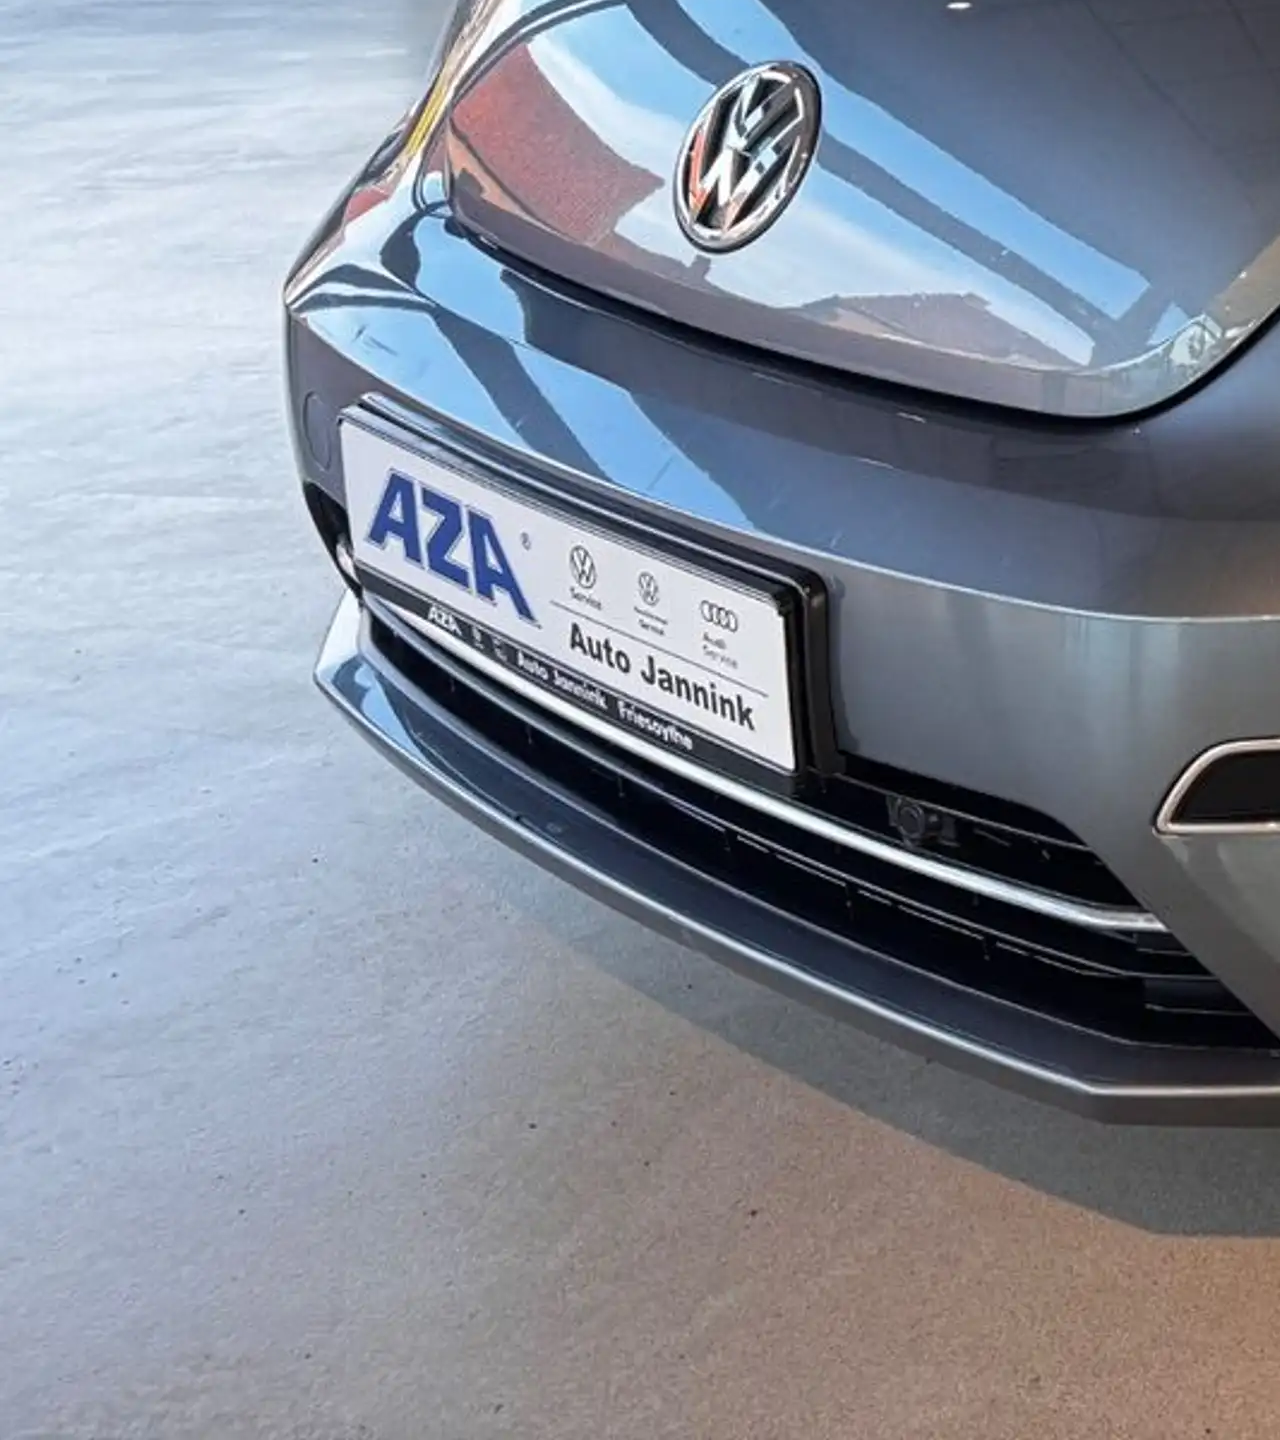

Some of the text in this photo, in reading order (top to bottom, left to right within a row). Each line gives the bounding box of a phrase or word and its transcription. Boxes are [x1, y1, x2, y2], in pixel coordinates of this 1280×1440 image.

[366, 471, 541, 628] AZA
[569, 622, 755, 732] Auto Jannink
